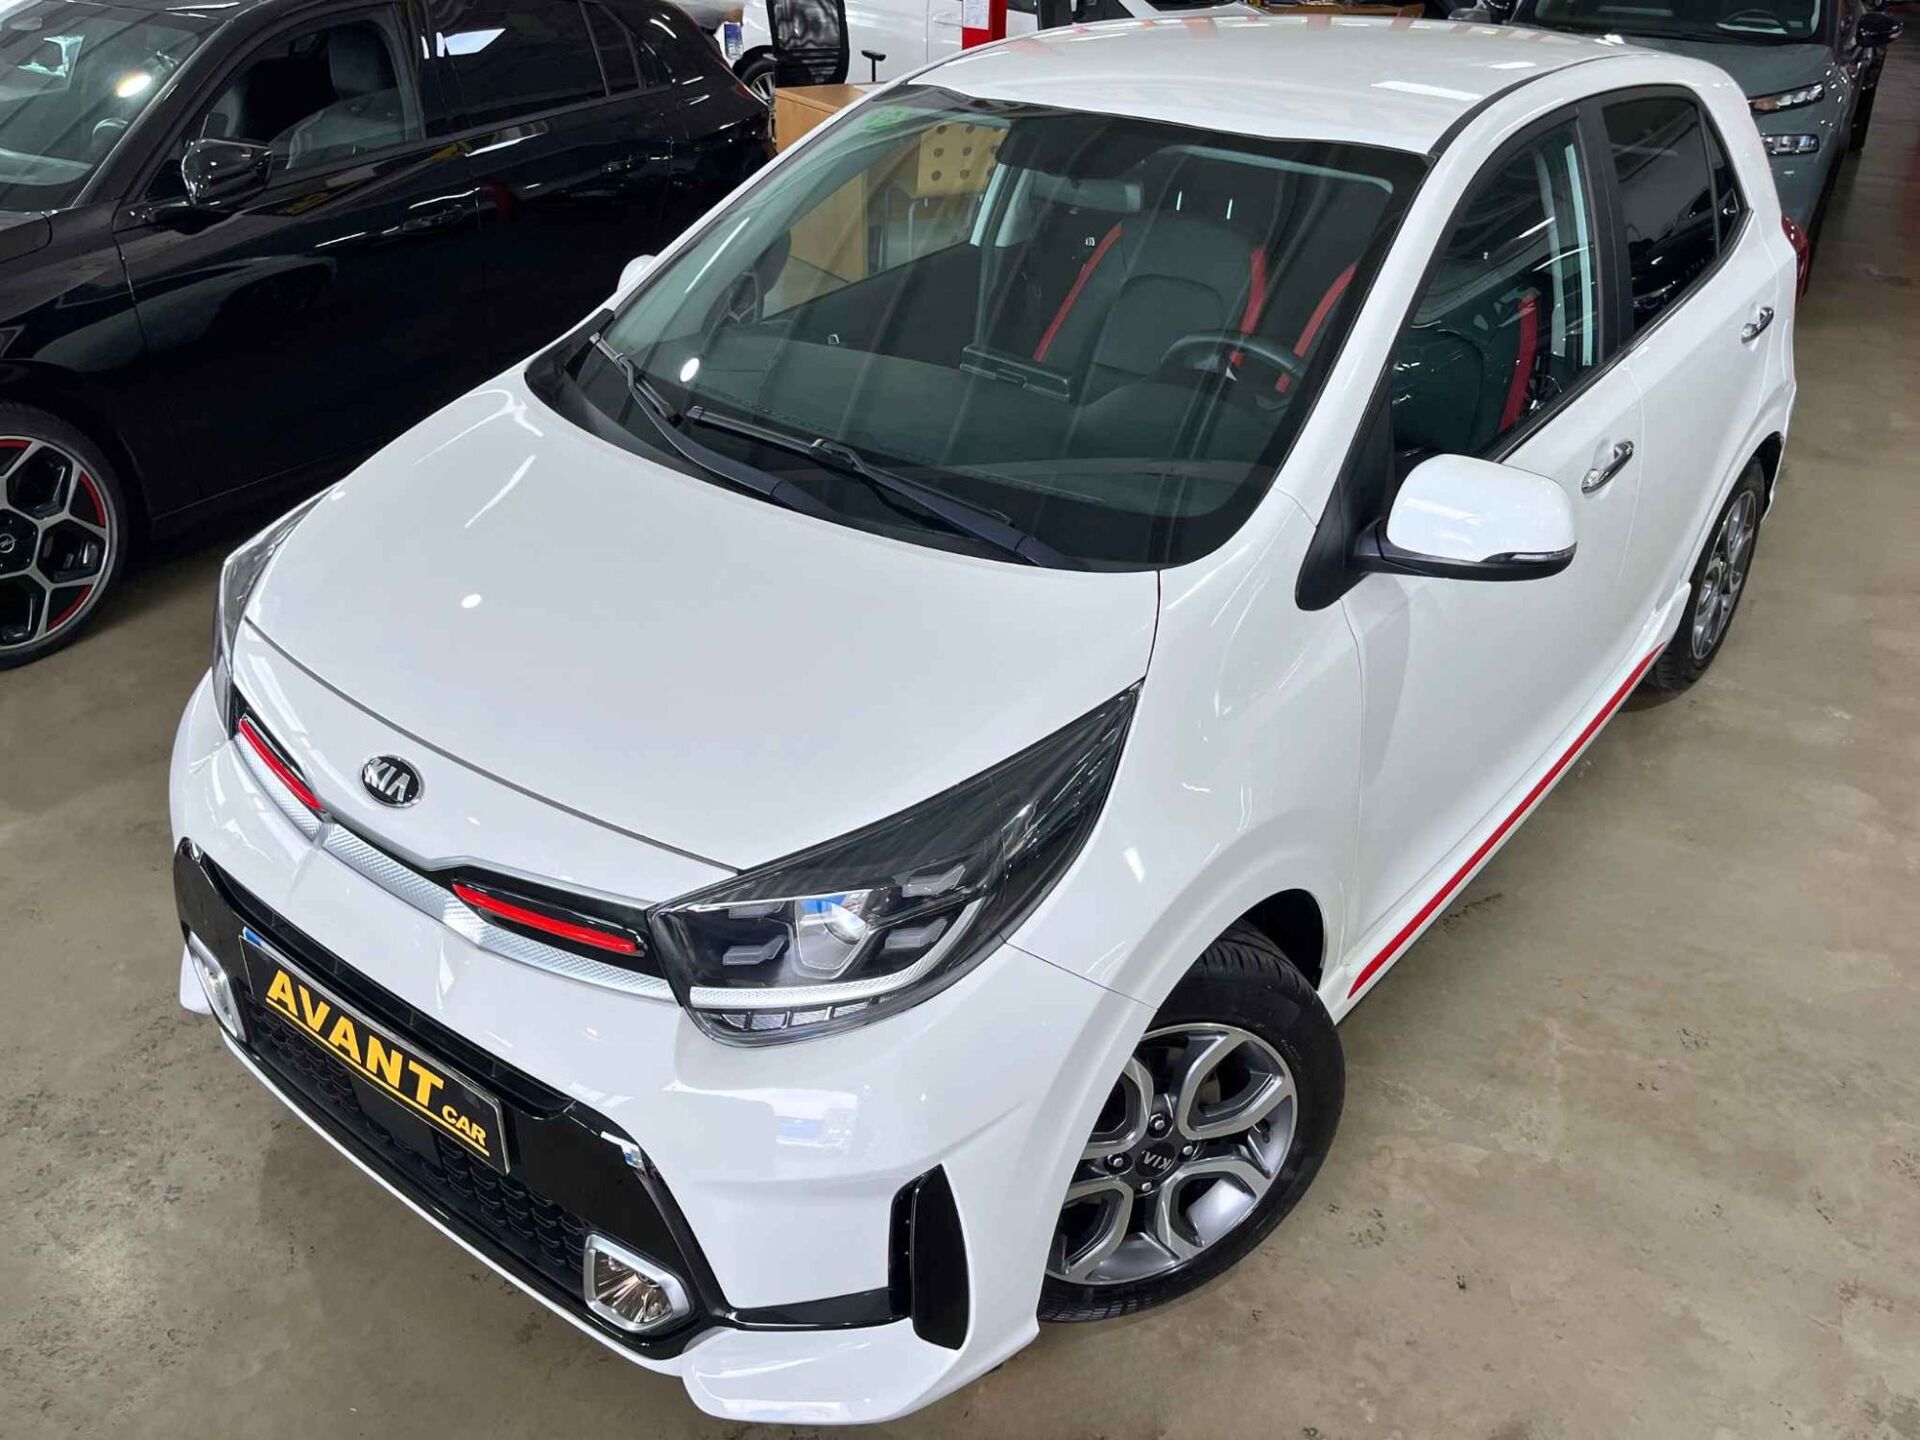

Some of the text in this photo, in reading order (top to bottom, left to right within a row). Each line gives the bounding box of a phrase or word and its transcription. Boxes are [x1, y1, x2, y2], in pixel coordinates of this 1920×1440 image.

[364, 758, 411, 802] KIA
[267, 970, 487, 1146] AVANT CAR
[1143, 1151, 1172, 1170] KIA
